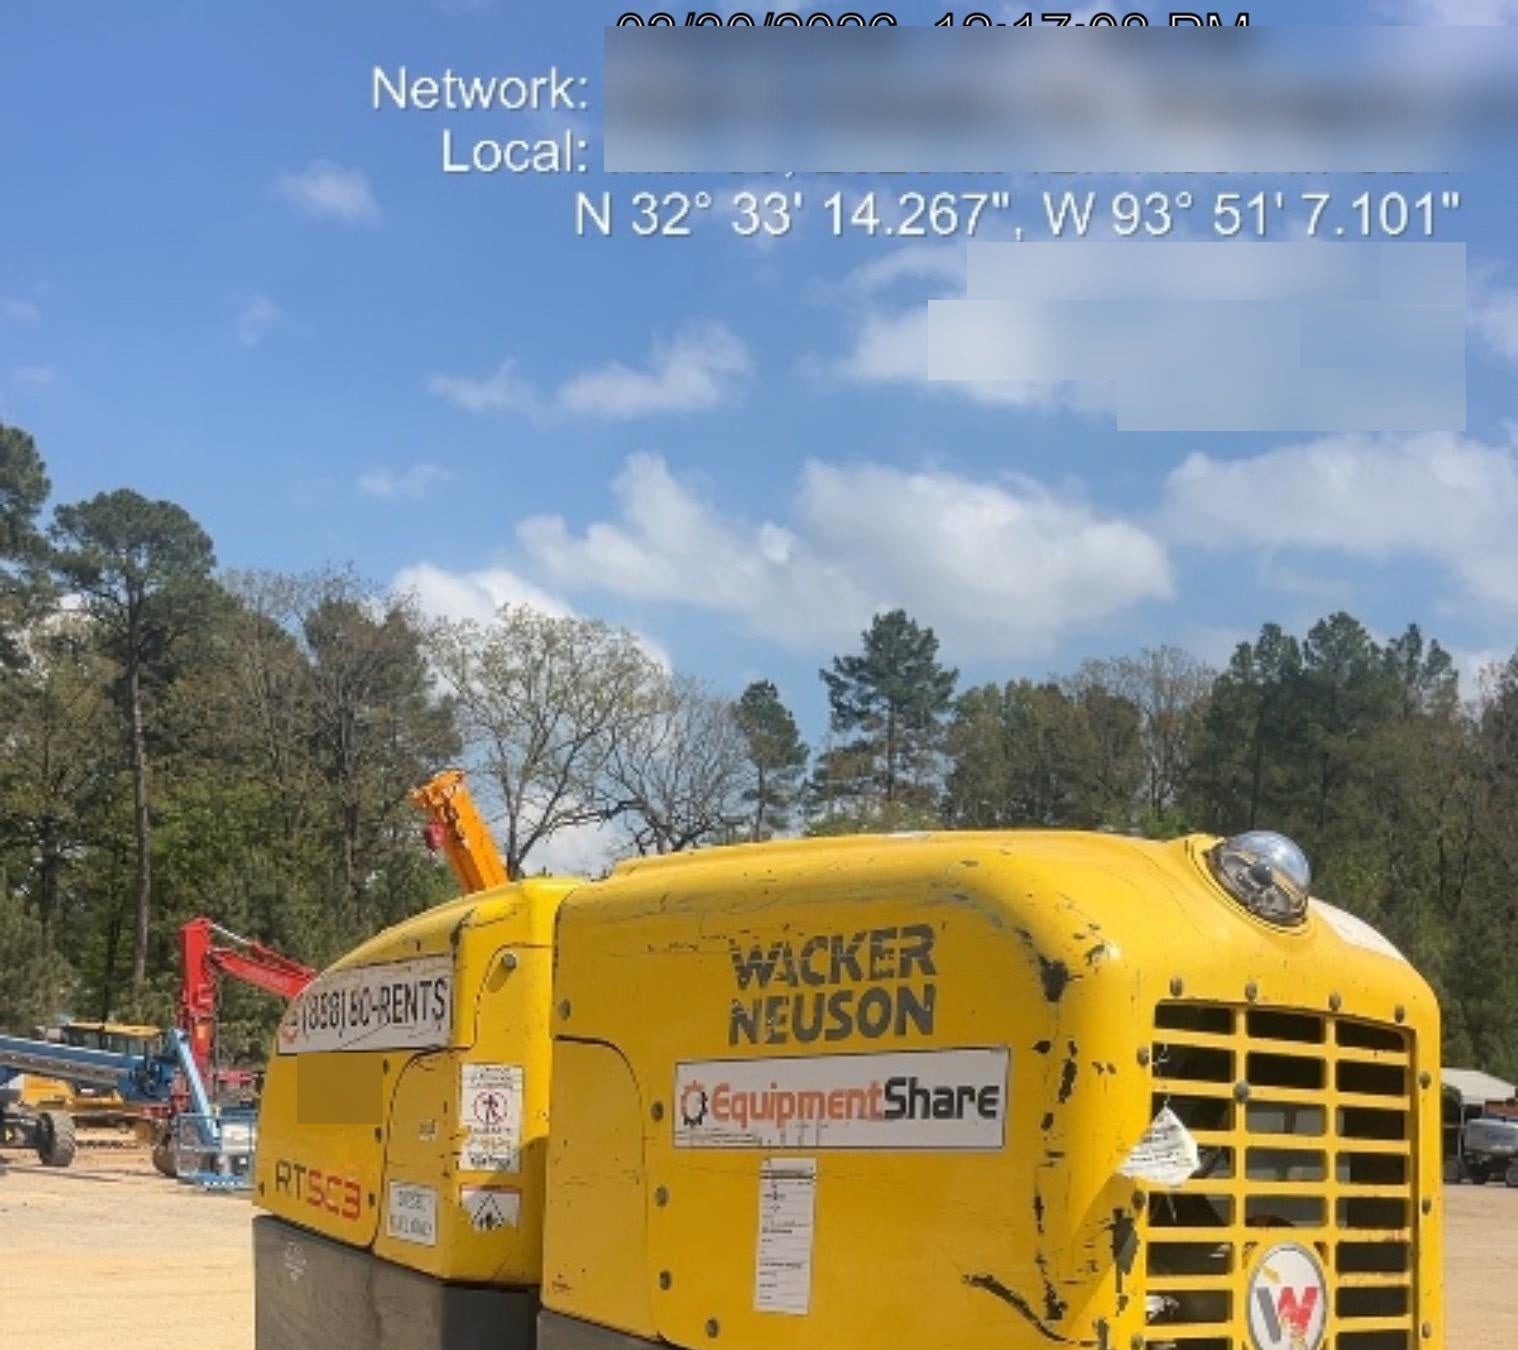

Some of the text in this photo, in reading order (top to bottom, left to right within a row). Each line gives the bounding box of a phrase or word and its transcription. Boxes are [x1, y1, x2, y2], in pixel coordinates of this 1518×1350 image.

[728, 923, 938, 990] WACKER
[728, 984, 937, 1047] NEUSON
[711, 1077, 1000, 1129] EquipmentShare
